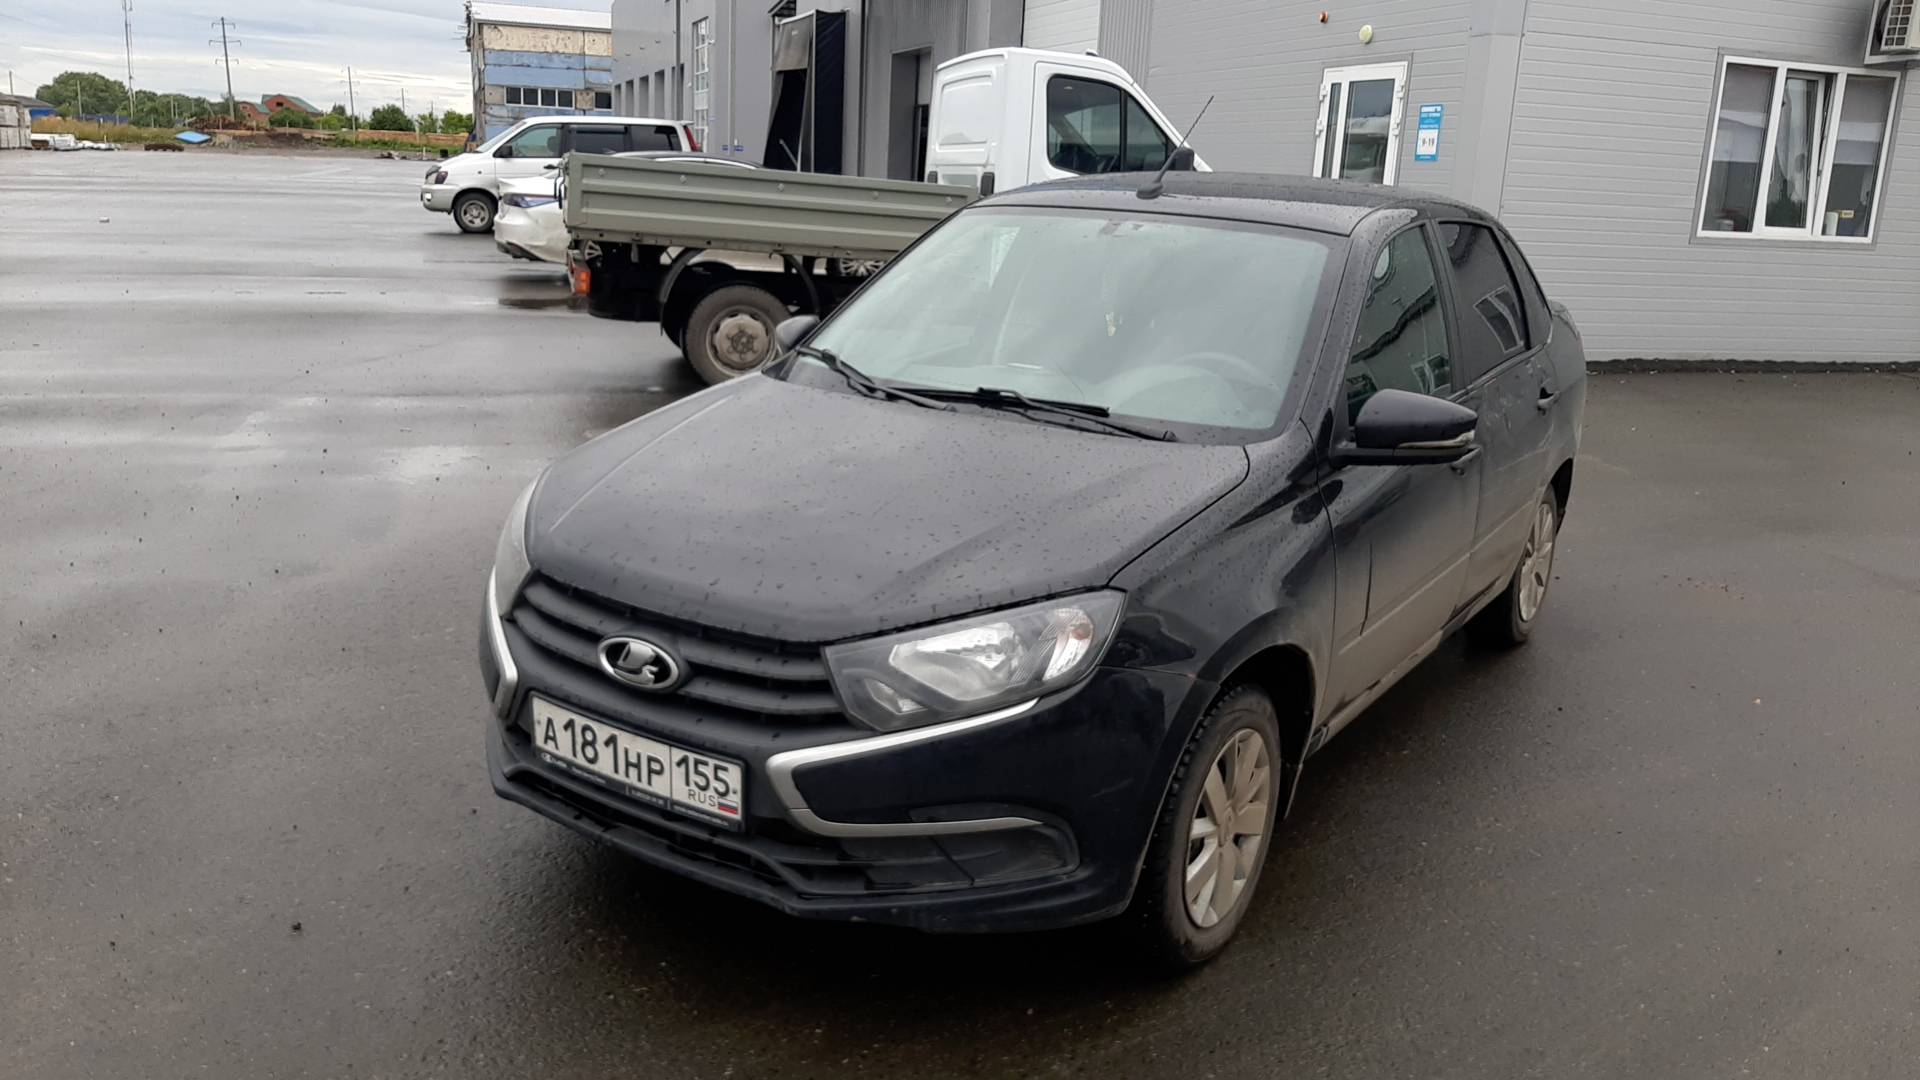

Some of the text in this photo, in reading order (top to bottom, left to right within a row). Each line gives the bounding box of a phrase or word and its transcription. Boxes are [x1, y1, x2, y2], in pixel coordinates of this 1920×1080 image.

[543, 717, 665, 787] А181НР
[676, 754, 731, 798] 155
[688, 788, 717, 807] RUS
